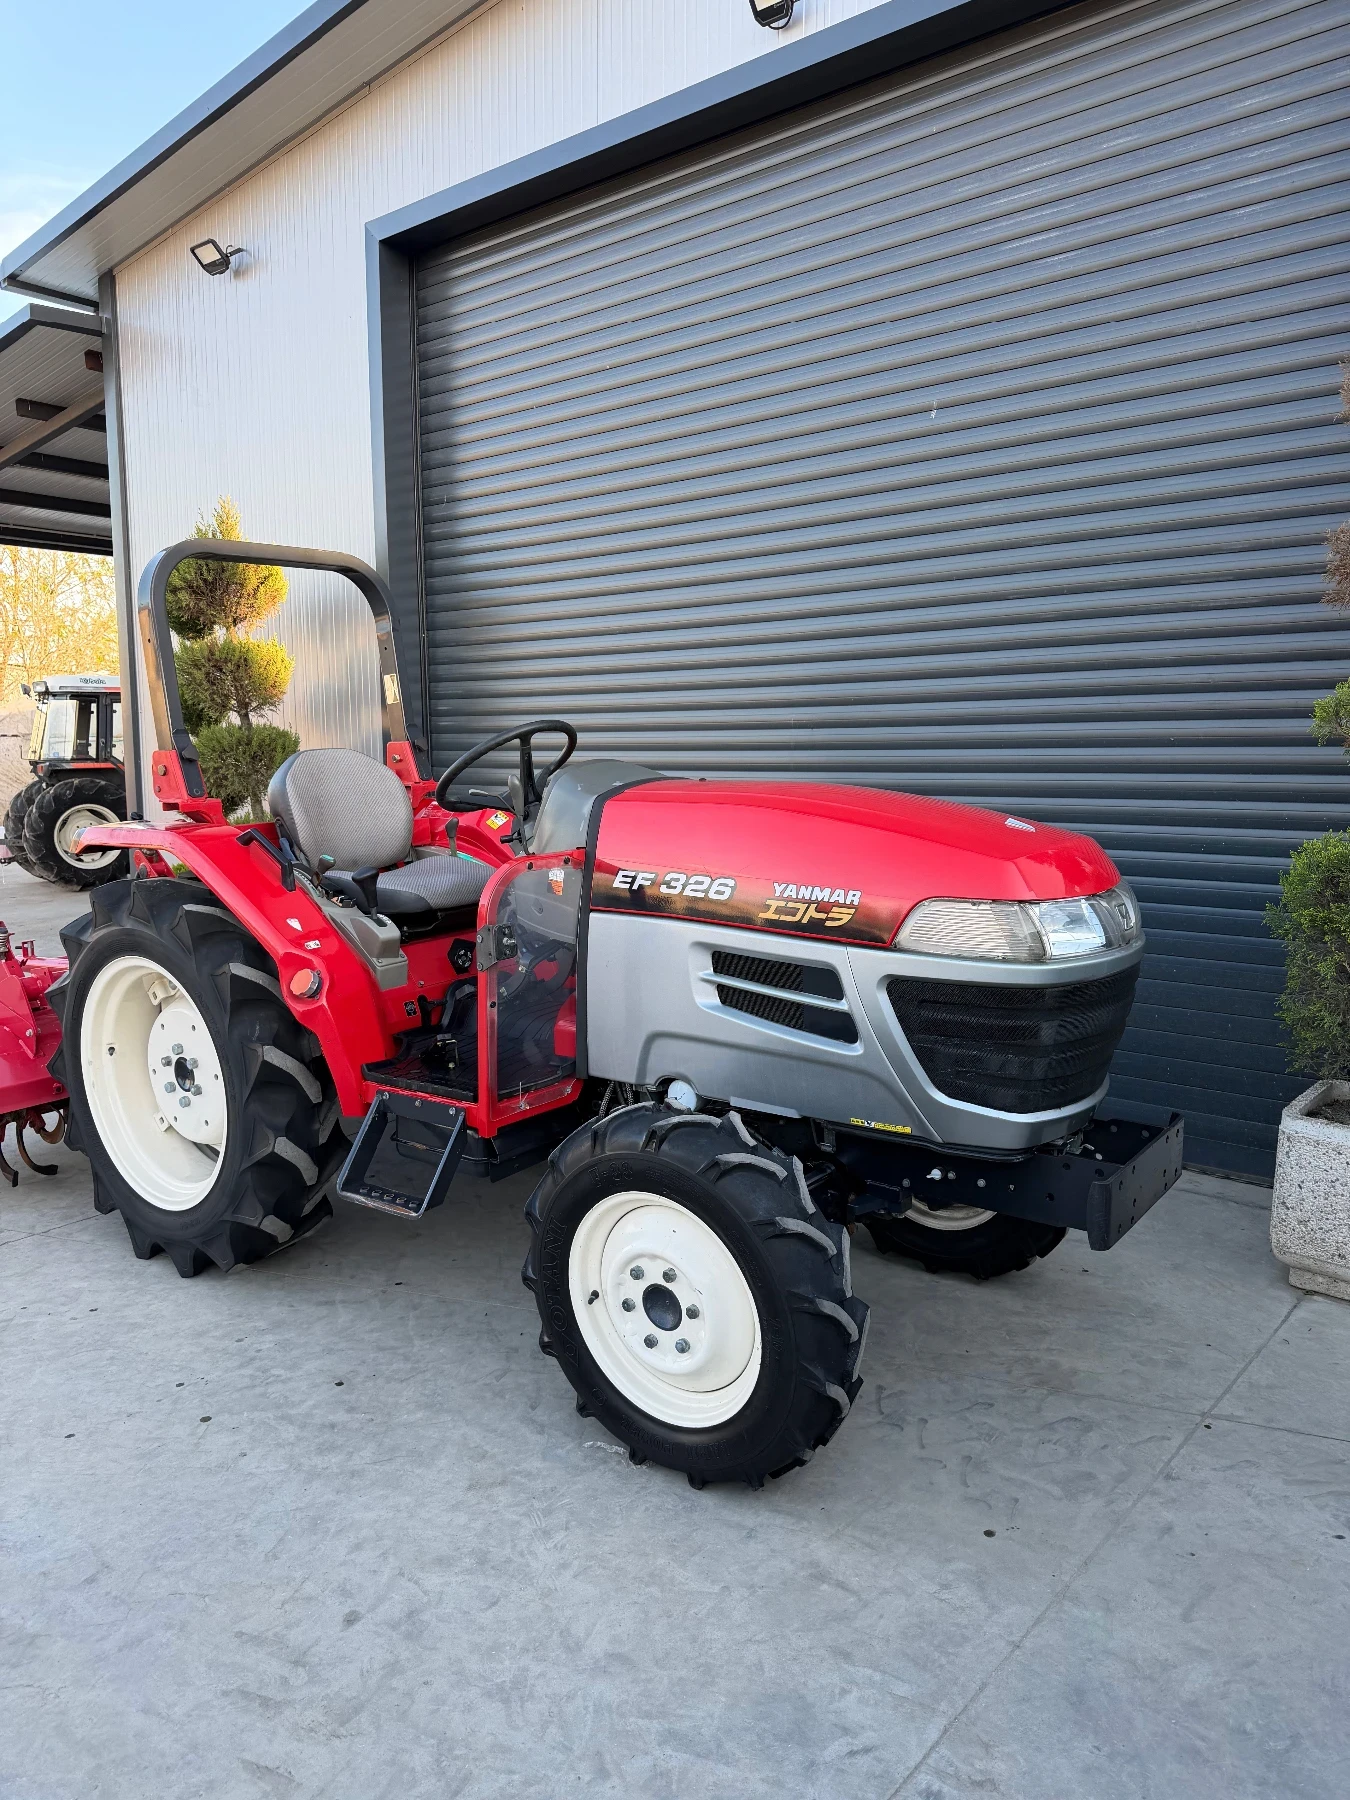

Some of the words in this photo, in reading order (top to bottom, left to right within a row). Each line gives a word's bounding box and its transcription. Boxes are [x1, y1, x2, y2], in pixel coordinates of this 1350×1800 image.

[612, 869, 656, 890] EF
[658, 871, 737, 901] 326
[772, 882, 862, 906] YANMAR
[758, 899, 856, 927] エコトラ
